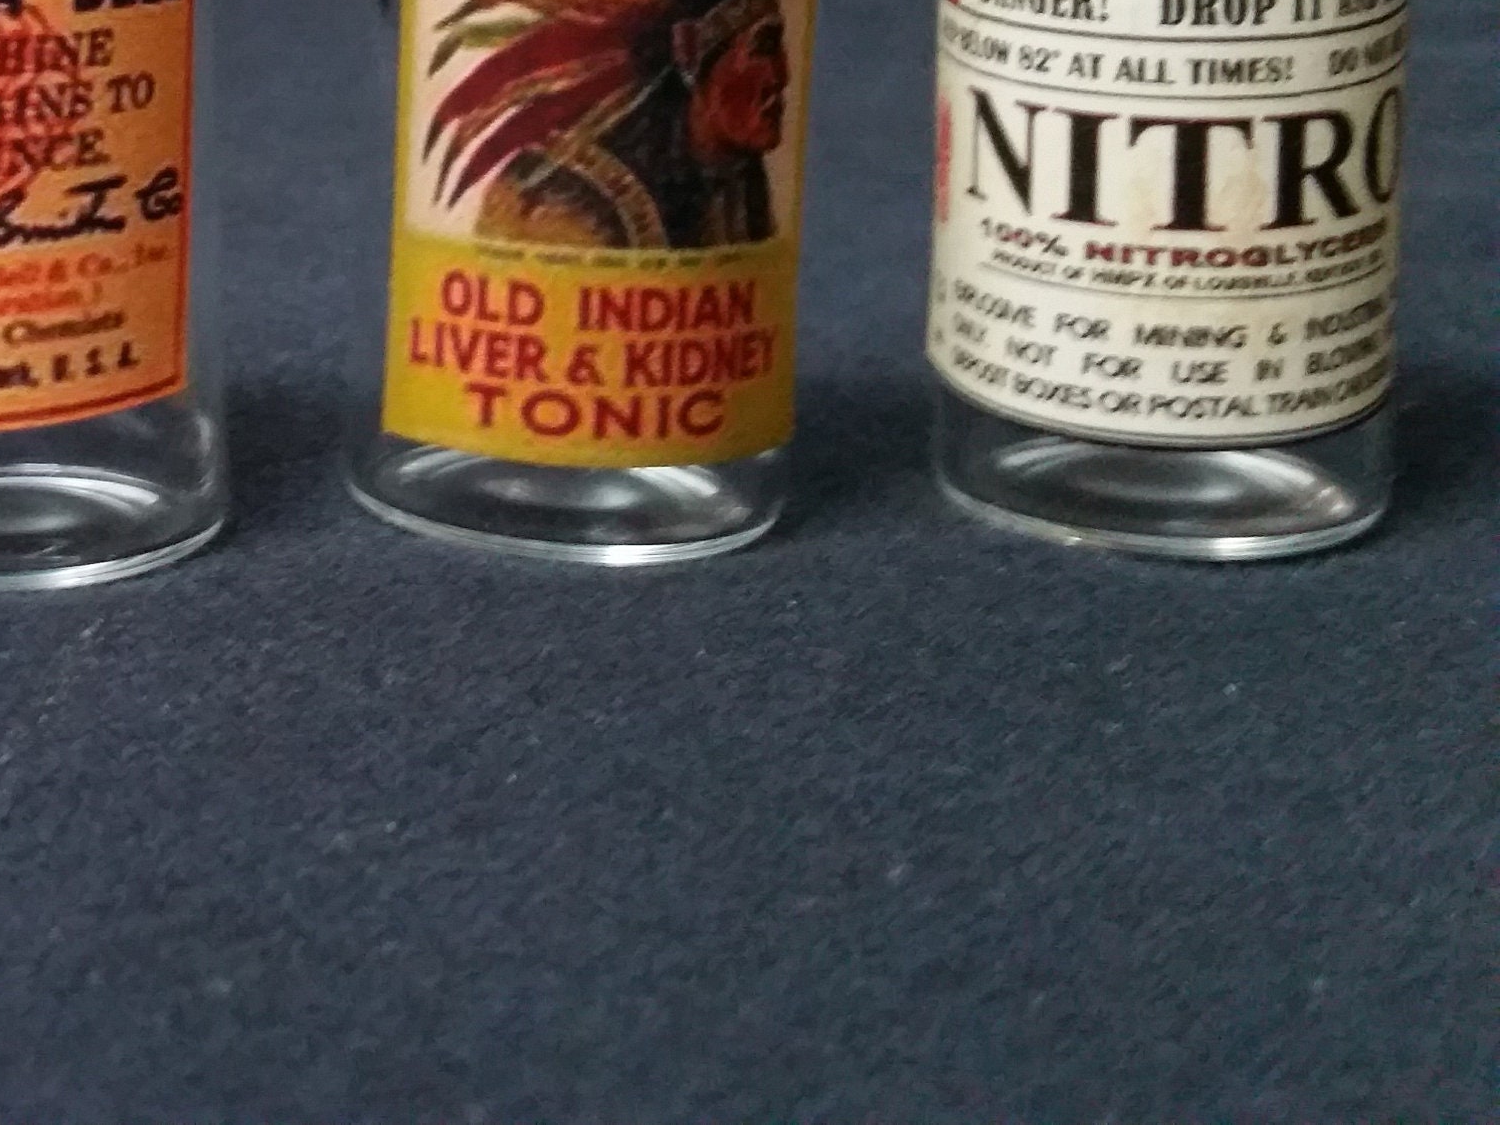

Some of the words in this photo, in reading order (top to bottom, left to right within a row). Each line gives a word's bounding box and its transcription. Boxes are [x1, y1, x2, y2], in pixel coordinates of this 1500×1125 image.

[1067, 50, 1105, 80] AT
[1112, 54, 1178, 84] ALL
[1188, 54, 1296, 85] TIMES!
[105, 73, 156, 115] TO
[966, 84, 1402, 232] NITRO
[980, 216, 1069, 257] 100%
[440, 268, 546, 327] OLD
[578, 279, 758, 332] INDIAN
[1053, 312, 1112, 340] FOR
[1267, 321, 1288, 346] &
[408, 317, 548, 383] LIVER
[566, 343, 605, 387] &
[621, 326, 780, 387] KIDNEY
[1005, 335, 1057, 367] NOT
[1081, 351, 1144, 380] FOR
[1171, 359, 1230, 383] USE
[1255, 359, 1286, 381] IN
[465, 381, 726, 439] TONIC
[1099, 390, 1144, 414] OR
[1147, 393, 1262, 419] POSTAL
